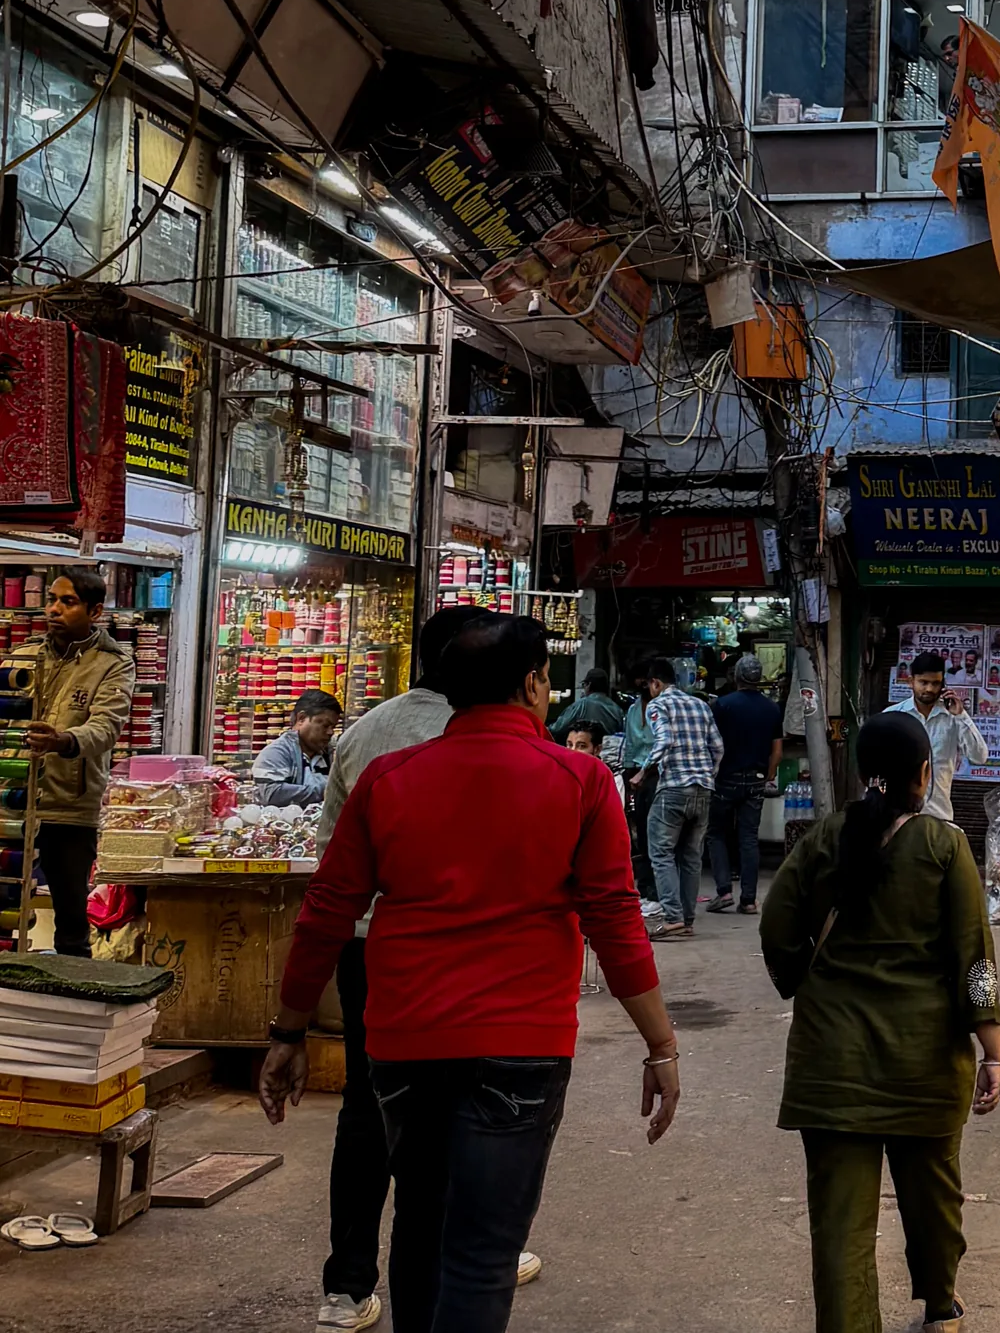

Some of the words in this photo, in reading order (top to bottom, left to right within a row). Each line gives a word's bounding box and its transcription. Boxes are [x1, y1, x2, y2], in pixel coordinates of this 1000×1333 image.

[424, 144, 471, 200] Kanha
[453, 180, 492, 227] Churi
[138, 408, 159, 428] Kind
[160, 415, 169, 430] of
[859, 465, 895, 499] SHRI
[899, 464, 961, 499] GANESHI
[964, 465, 997, 498] LAL
[227, 502, 287, 541] KANHA
[296, 517, 337, 550] HURI
[340, 525, 405, 562] BHANDAR
[883, 508, 989, 536] NEERAJ
[682, 530, 747, 563] STING
[874, 539, 914, 553] Wholesale
[917, 539, 942, 553] Dealer
[868, 565, 888, 575] Shop
[889, 565, 900, 574] No
[913, 565, 939, 575] Tiraha
[940, 565, 963, 575] Kinari
[965, 566, 989, 576] Bazar,
[919, 633, 957, 646] विशाल
[959, 633, 979, 645] रैली
